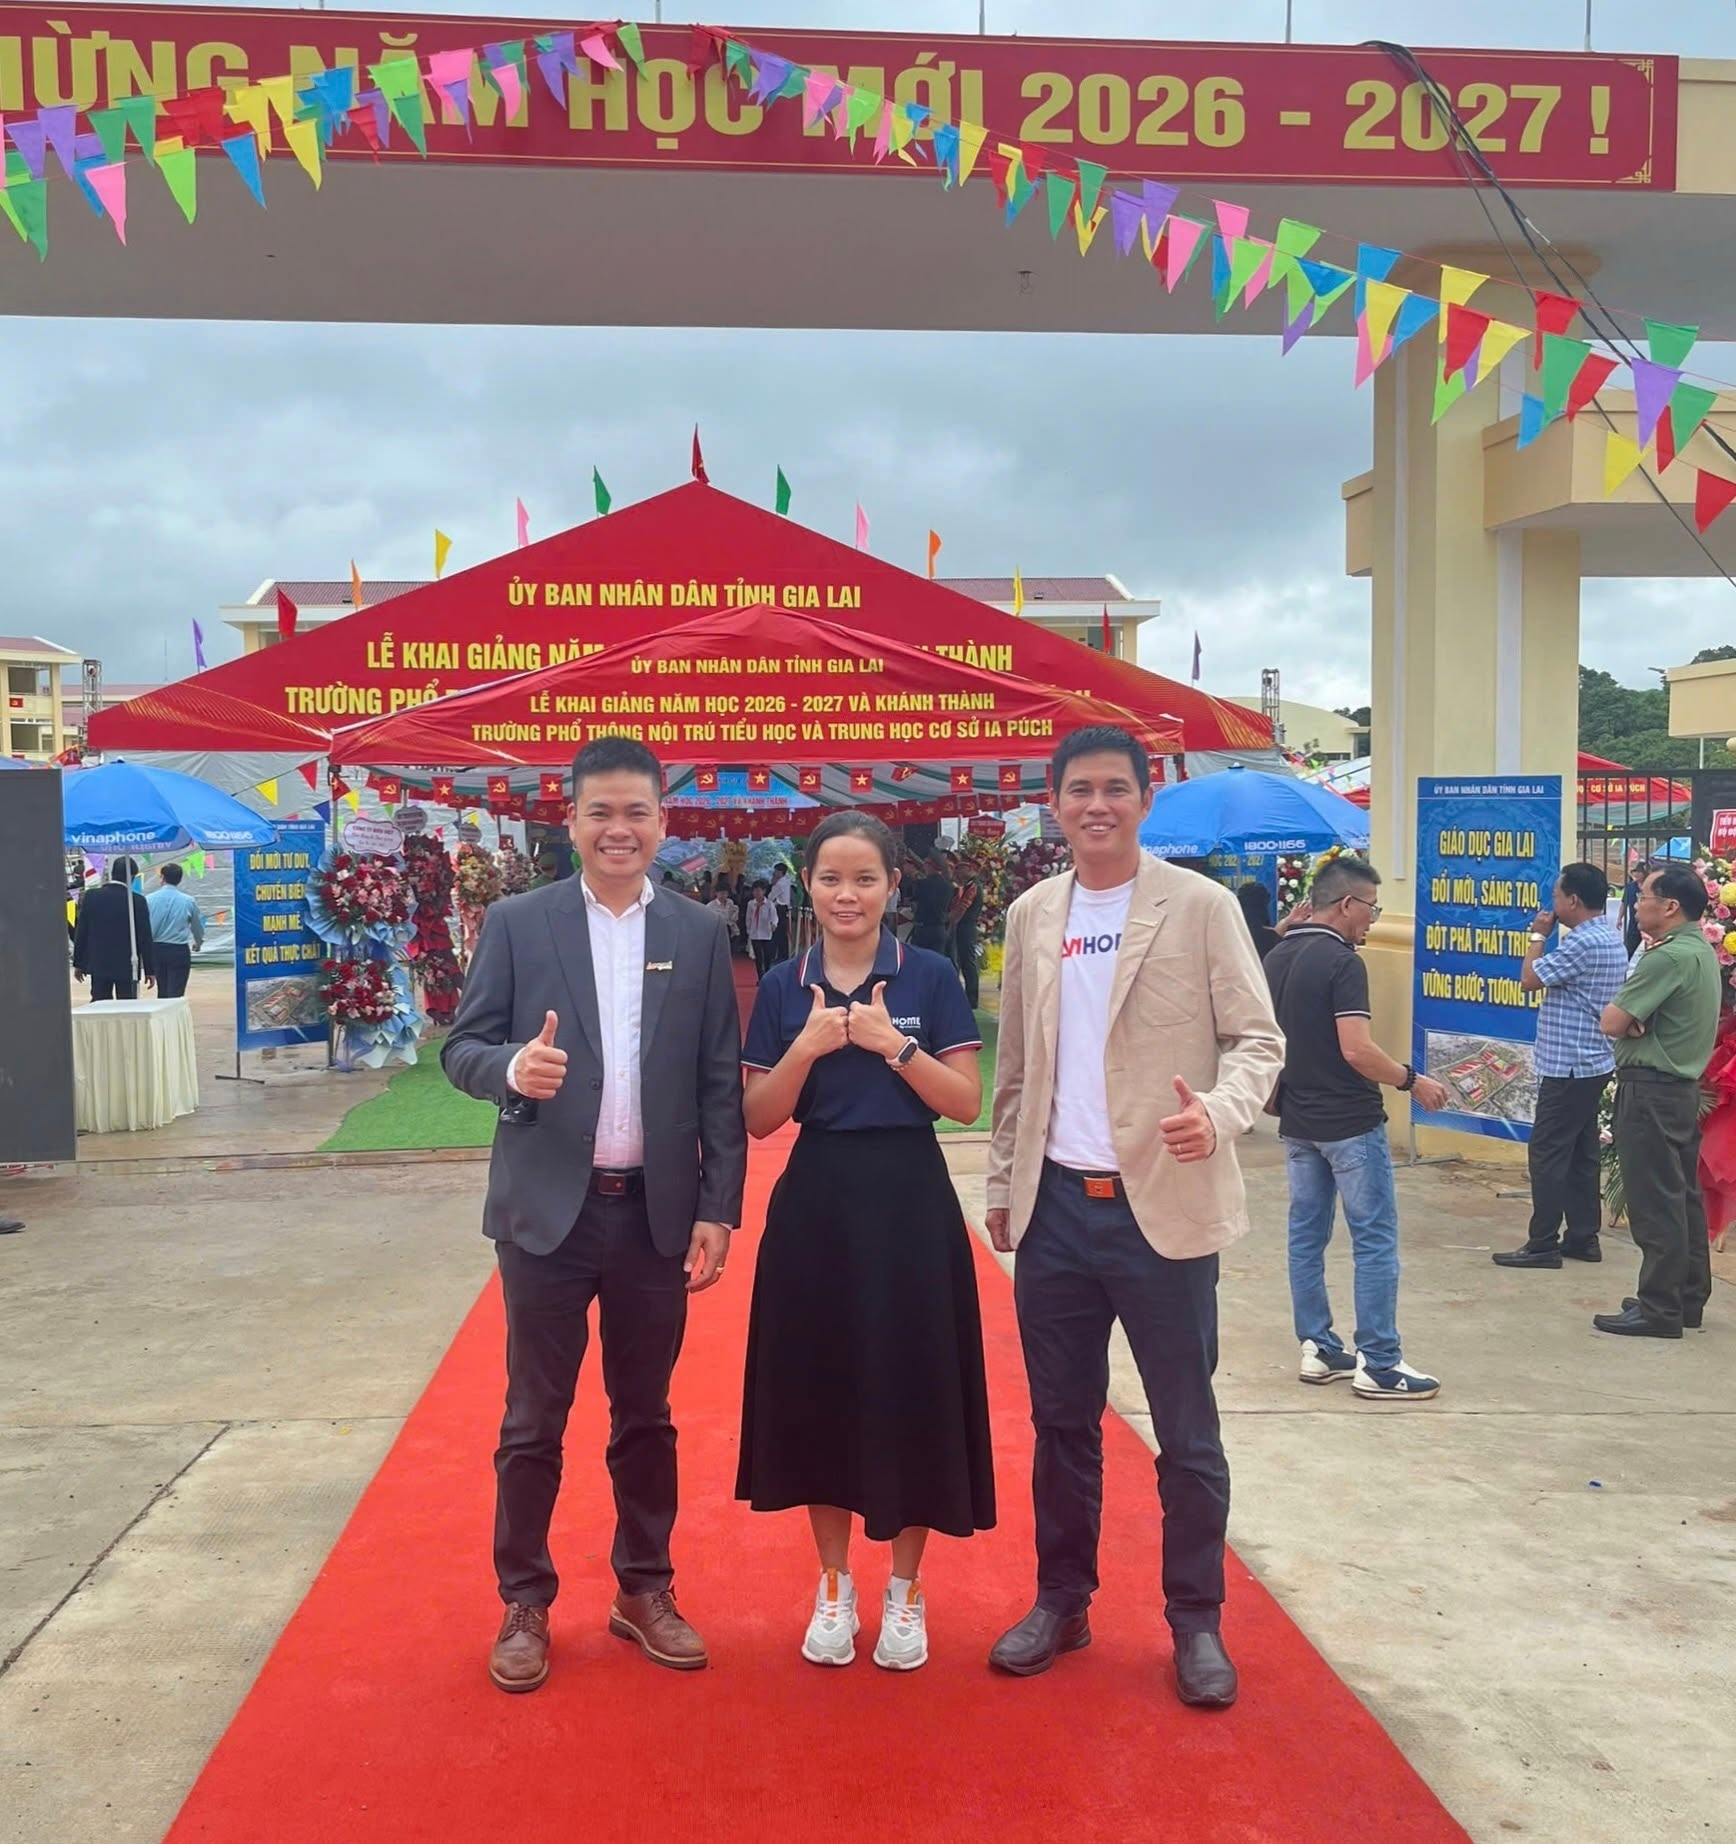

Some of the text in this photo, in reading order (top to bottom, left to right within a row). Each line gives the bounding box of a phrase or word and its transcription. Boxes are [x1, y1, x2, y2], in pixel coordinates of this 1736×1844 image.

[568, 57, 765, 150] HỌC
[1019, 72, 1246, 147] 2026
[1280, 111, 1312, 127] -
[1343, 79, 1562, 154] 2027
[508, 575, 861, 608] ỦY BAN NHÂN DÂN TỈNH GIA LAI
[367, 631, 395, 669] LỄ
[402, 641, 460, 670] KHAI
[467, 633, 542, 671] GIẢNG
[631, 654, 884, 674] ỦY BAN NHÂN DÂN TỈNH GIA LAI
[285, 681, 383, 715] TRƯỜNG
[530, 689, 550, 713] LỄ
[556, 694, 596, 713] KHAI
[602, 690, 655, 713] GIẢNG
[660, 692, 700, 713] NĂM
[705, 696, 739, 717] HỌC
[745, 694, 786, 713] 2026
[803, 694, 843, 713] 2027
[849, 692, 871, 712] VÀ
[876, 690, 933, 711] KHÁNH
[939, 689, 995, 710] THÀNH
[472, 721, 541, 742] TRƯỜNG
[546, 718, 582, 742] PHỔ
[648, 720, 678, 745] NỘI
[683, 720, 716, 742] TRÚ
[720, 716, 758, 741] TIỂU
[763, 724, 797, 744] HỌC
[802, 720, 823, 741] VÀ
[828, 724, 884, 742] TRUNG
[890, 724, 924, 743] HỌC
[929, 721, 952, 739] CƠ
[957, 715, 980, 739] SỞ
[985, 721, 1002, 739] IA
[1007, 716, 1053, 737] PÚCH
[1445, 786, 1459, 794] BAN
[1518, 785, 1530, 794] GIA
[1532, 785, 1544, 794] LAI
[71, 831, 156, 845] vinaphone
[1440, 823, 1535, 862] GIÁO DỤC GIA LAI
[1431, 868, 1542, 912] ĐỔI MỚI, SÁNG TẠO,
[1426, 920, 1448, 955] ĐỘT
[1450, 923, 1472, 952] PHÁ
[1475, 925, 1505, 955] PHÁT
[1455, 971, 1485, 1003] BƯỚC
